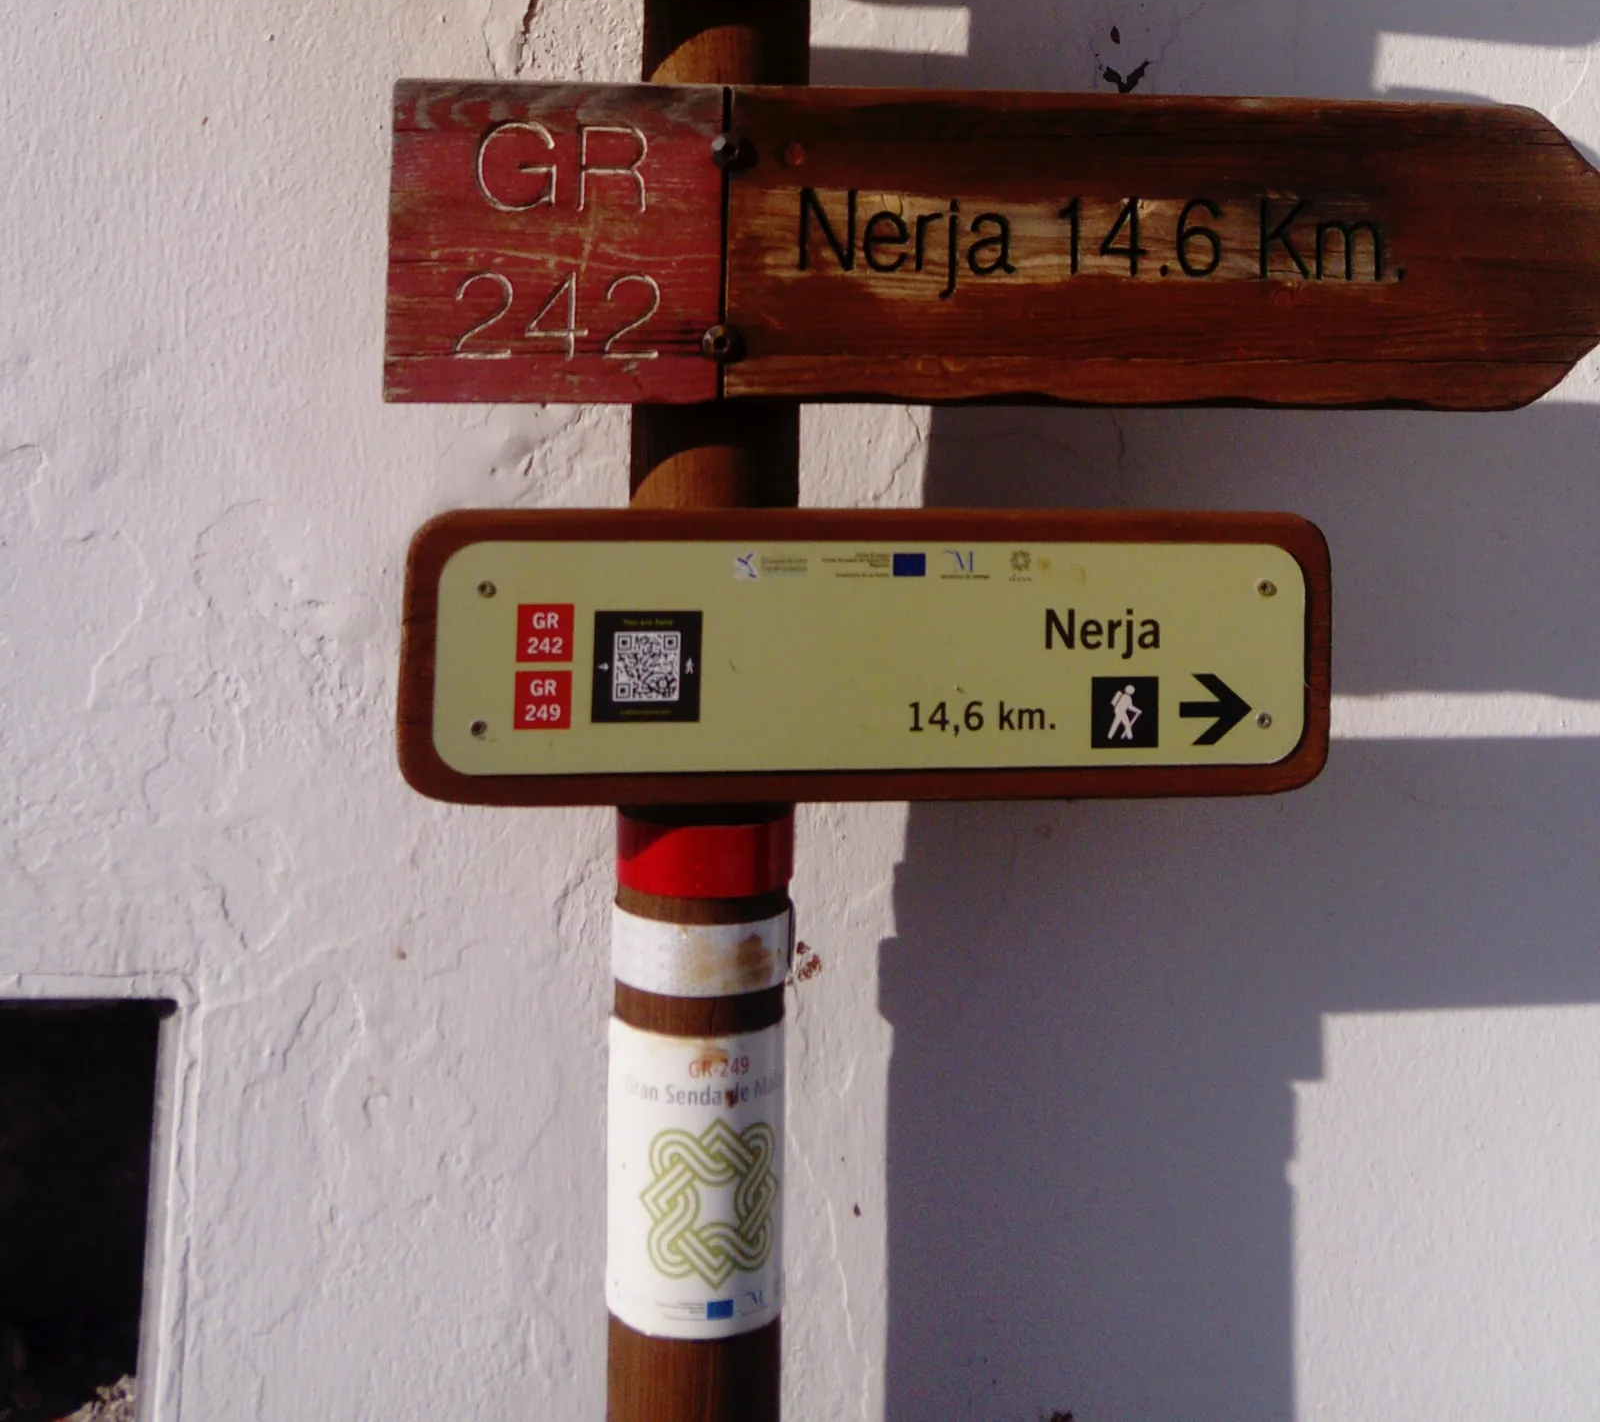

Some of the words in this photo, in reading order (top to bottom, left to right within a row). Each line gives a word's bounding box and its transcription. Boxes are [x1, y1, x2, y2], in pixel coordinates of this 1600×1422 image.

[475, 121, 649, 215] GR
[798, 186, 1017, 299] Nerja
[1060, 196, 1224, 278] 14.6
[1259, 197, 1406, 282] Km.
[453, 270, 662, 364] 242
[532, 611, 560, 630] GR
[526, 636, 563, 655] 242
[1043, 607, 1163, 660] Nerja
[529, 678, 558, 697] GR
[524, 703, 562, 722] 249
[907, 700, 985, 738] 14,6
[998, 699, 1058, 731] km.
[688, 1056, 750, 1080] GR-249
[665, 1083, 723, 1107] Senda
